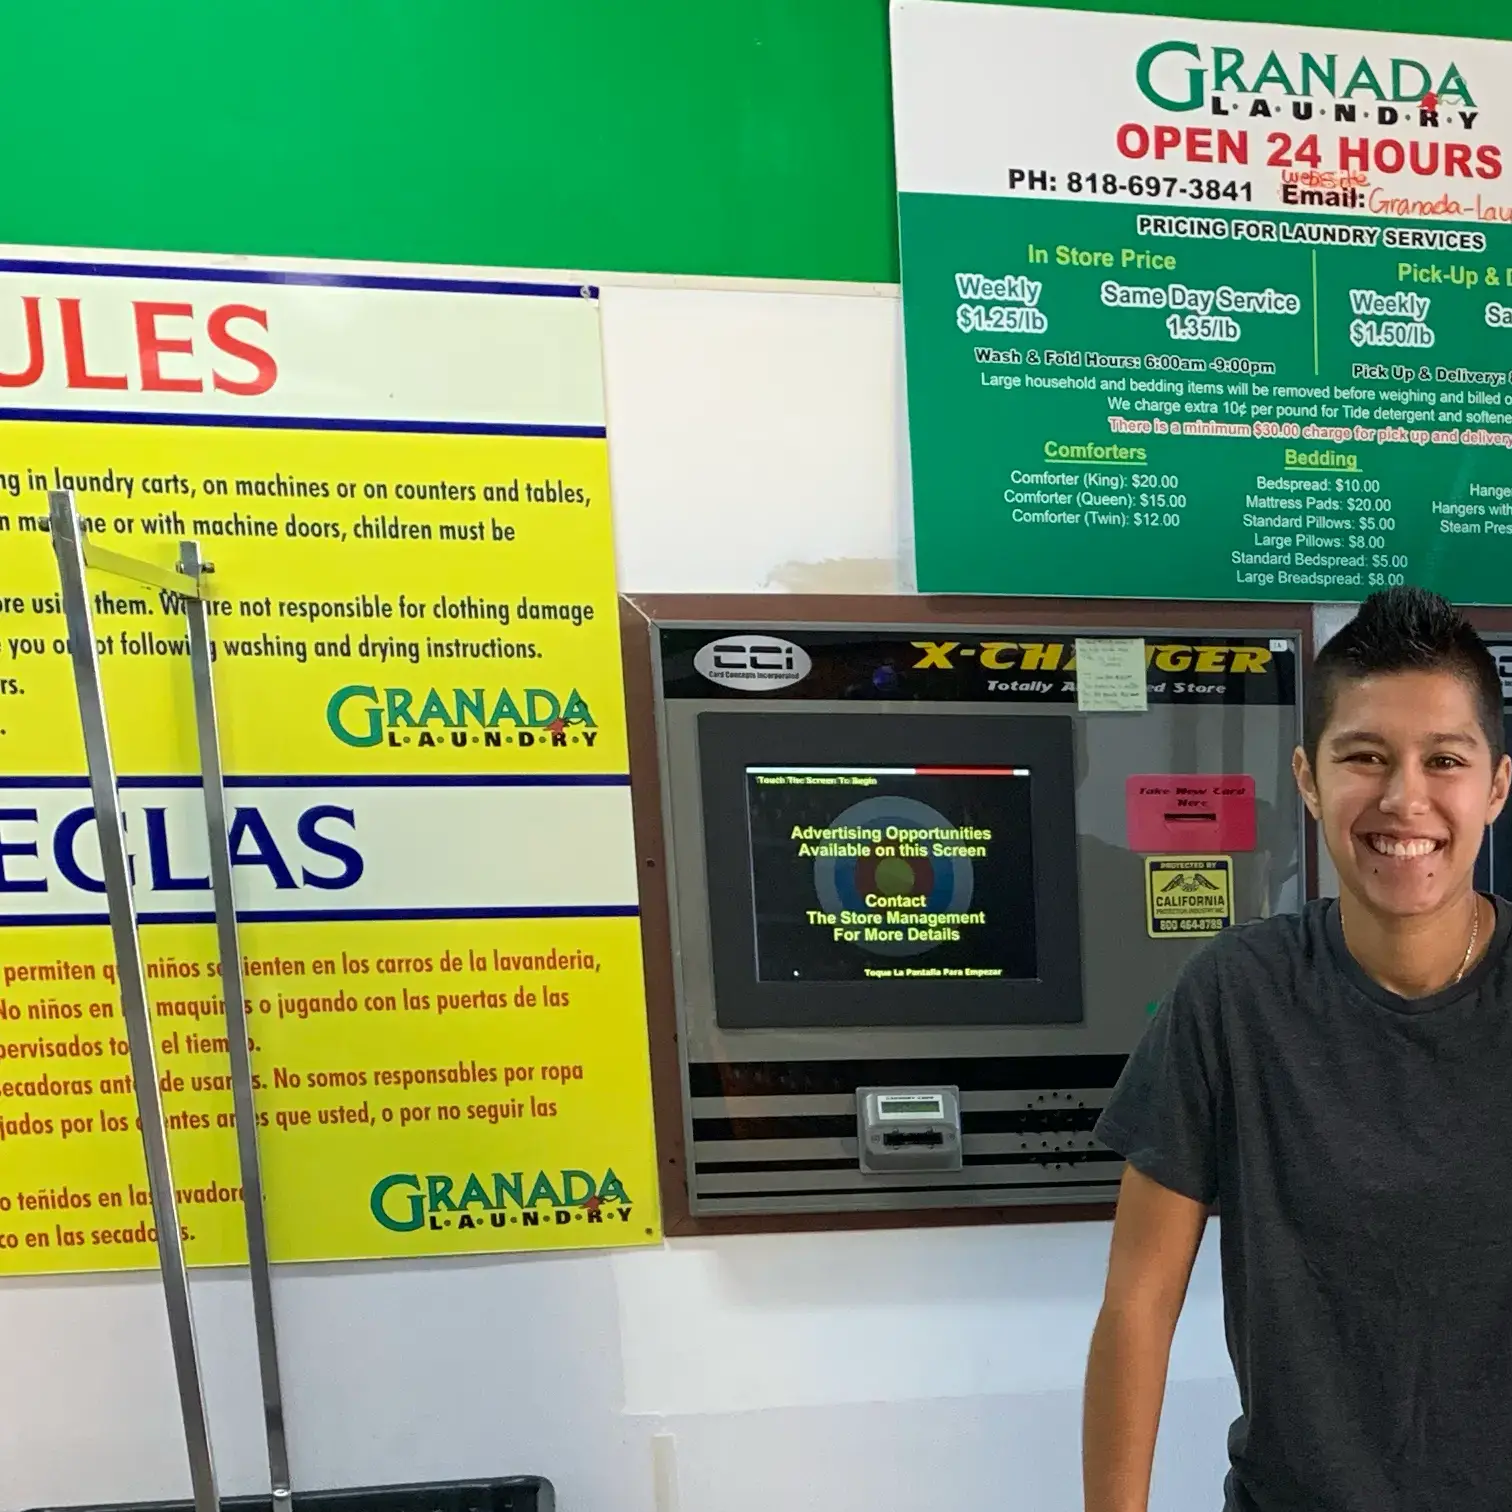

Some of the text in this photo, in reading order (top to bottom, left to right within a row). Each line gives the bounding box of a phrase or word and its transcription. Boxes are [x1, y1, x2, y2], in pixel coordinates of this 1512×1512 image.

[1136, 40, 1477, 112] GRANADA
[1116, 123, 1502, 179] OPEN 24 HOURS
[1008, 169, 1365, 208] PH: 818-697-3841 Email:
[1138, 216, 1485, 251] PRICING FOR LAUNDRY SERVICES
[1028, 244, 1176, 270] In Store Price
[1398, 263, 1478, 288] Pick-Up
[1485, 268, 1499, 286] &
[957, 274, 1041, 304] Weekly
[1102, 282, 1299, 312] Same Day Service
[1351, 291, 1429, 319] Weekly
[959, 307, 1046, 331] $1.25/lb
[1168, 316, 1239, 340] 1.35/lb
[1352, 322, 1434, 346] $1.50/lb
[981, 372, 1021, 388] Large
[1025, 374, 1096, 390] household
[1100, 377, 1126, 391] and
[1130, 378, 1183, 396] bedding
[1188, 380, 1224, 395] items
[1228, 381, 1248, 396] will
[1252, 382, 1269, 396] be
[1272, 383, 1331, 399] removed
[1334, 387, 1375, 401] before
[1379, 388, 1436, 404] weighing
[1440, 390, 1464, 403] and
[1468, 391, 1500, 405] billed
[1044, 441, 1147, 461] Comforters
[1285, 449, 1357, 470] Bedding
[28, 468, 590, 507] in laundry carts, on machines or on counters and tables,
[1010, 471, 1179, 490] Comforter (King): $20.00
[1236, 570, 1404, 589] Large Breadspread: $8.00
[279, 594, 594, 626] responsible for clothing damage
[911, 641, 1272, 674] X-CHGER
[986, 680, 1226, 694] Totally Store
[326, 684, 598, 747] GRANADA
[791, 826, 992, 843] Advertising Opportunities
[798, 843, 986, 857] Available on this Screen
[865, 894, 926, 908] Contact
[1156, 895, 1224, 907] CALIFORNIA
[806, 911, 985, 927] The Store Management
[834, 928, 960, 941] For More Details
[4, 948, 601, 986] permiten niños en los carros de la lavanderia,
[864, 968, 891, 977] Toque
[965, 969, 1002, 977] Empezar
[274, 1060, 583, 1090] No somos responsables por ropa
[370, 1167, 632, 1232] GRANADA
